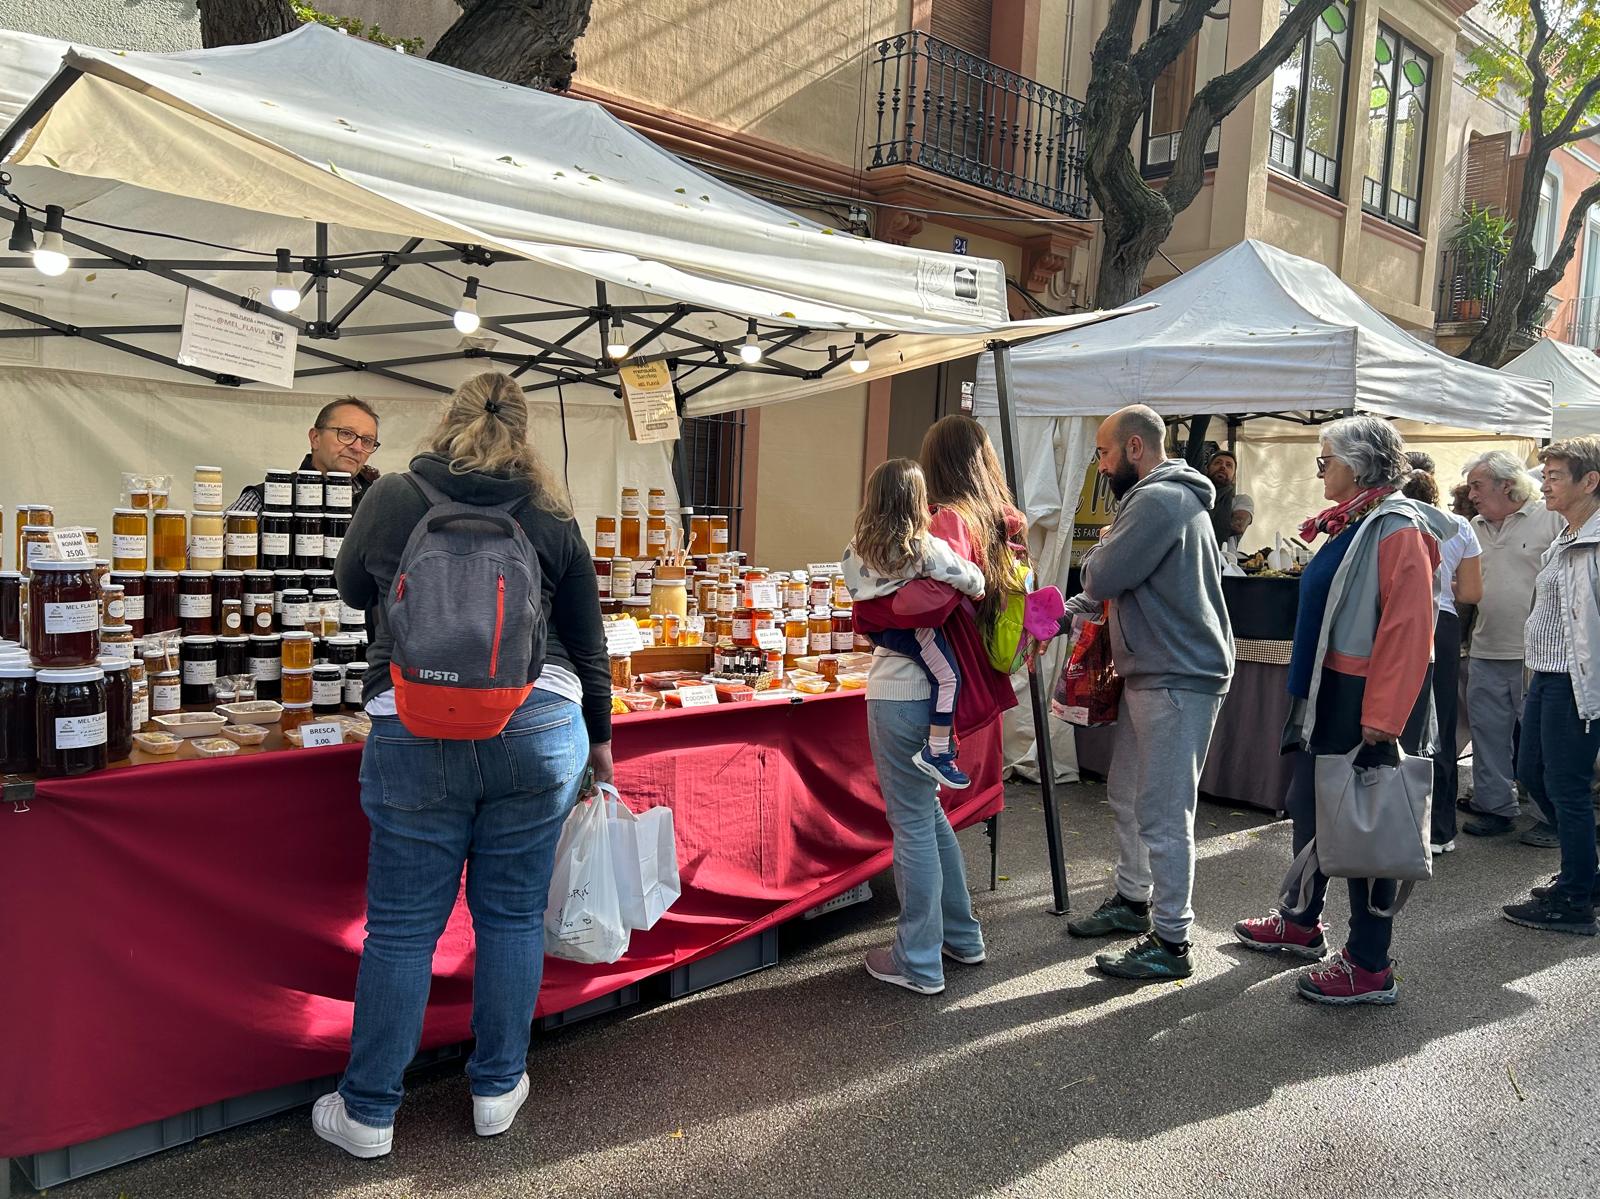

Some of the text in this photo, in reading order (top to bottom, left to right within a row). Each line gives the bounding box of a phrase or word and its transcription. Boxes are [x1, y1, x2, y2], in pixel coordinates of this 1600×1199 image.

[955, 238, 966, 254] 24
[57, 531, 82, 540] FARIGOLA
[309, 727, 336, 735] BRESCA
